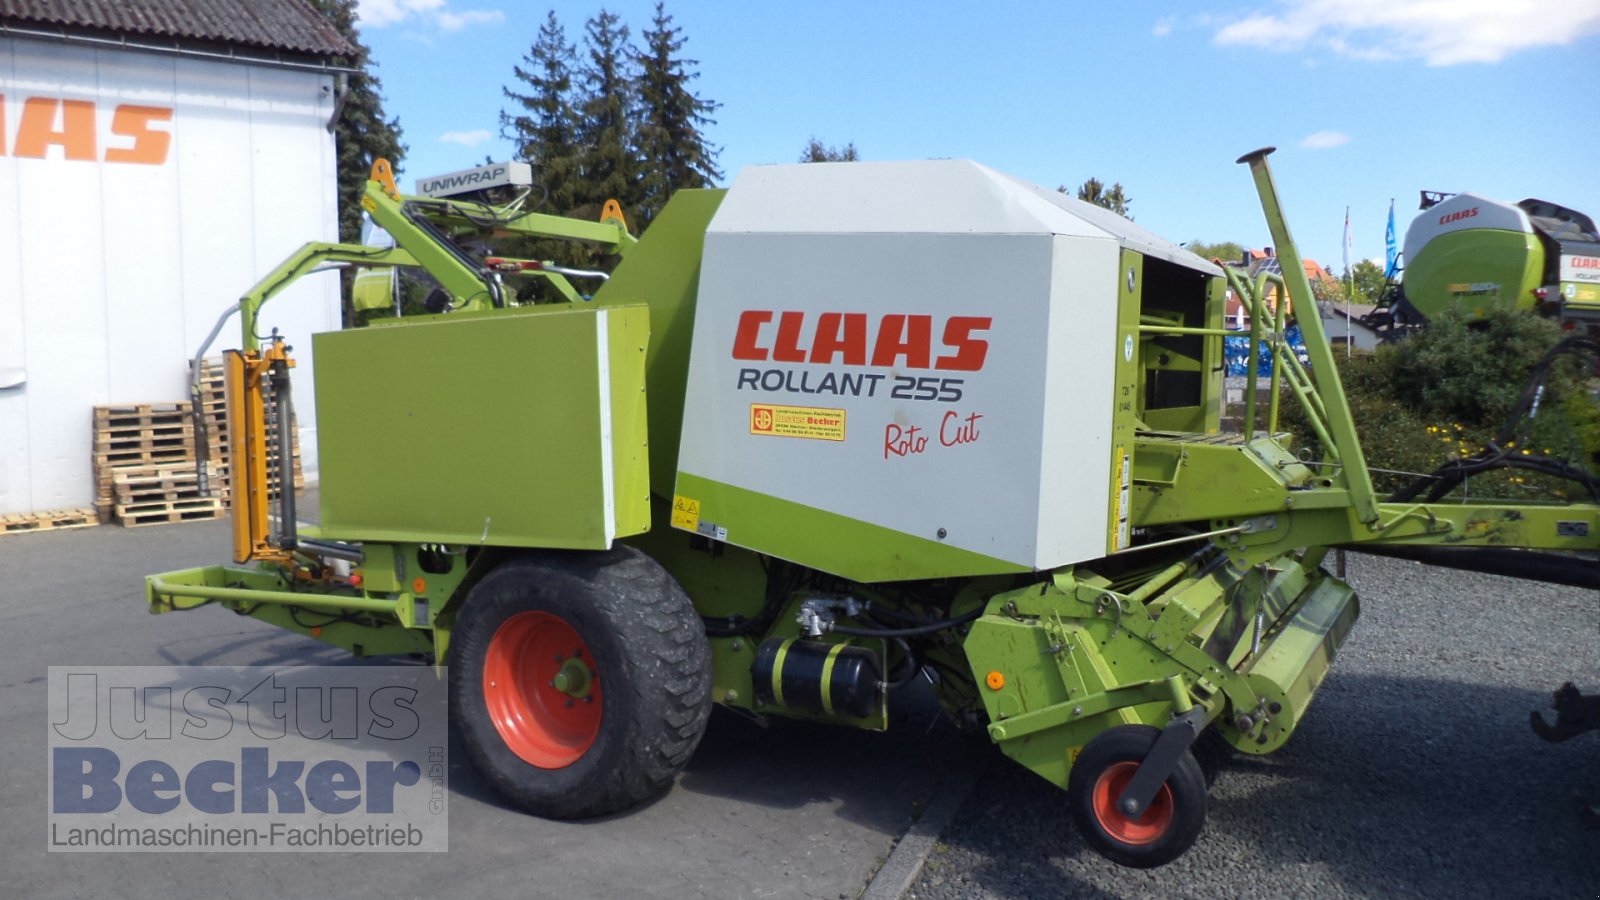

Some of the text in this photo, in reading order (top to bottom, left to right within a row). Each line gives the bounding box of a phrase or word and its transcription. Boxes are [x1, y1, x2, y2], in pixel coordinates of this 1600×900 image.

[0, 94, 175, 166] AS
[423, 167, 505, 193] UNIWRAP
[1439, 207, 1480, 225] CLAAS
[732, 310, 992, 371] CLAAS
[737, 368, 964, 402] ROLLANT 255
[806, 416, 840, 426] Becker
[884, 411, 984, 460] Roto Cut
